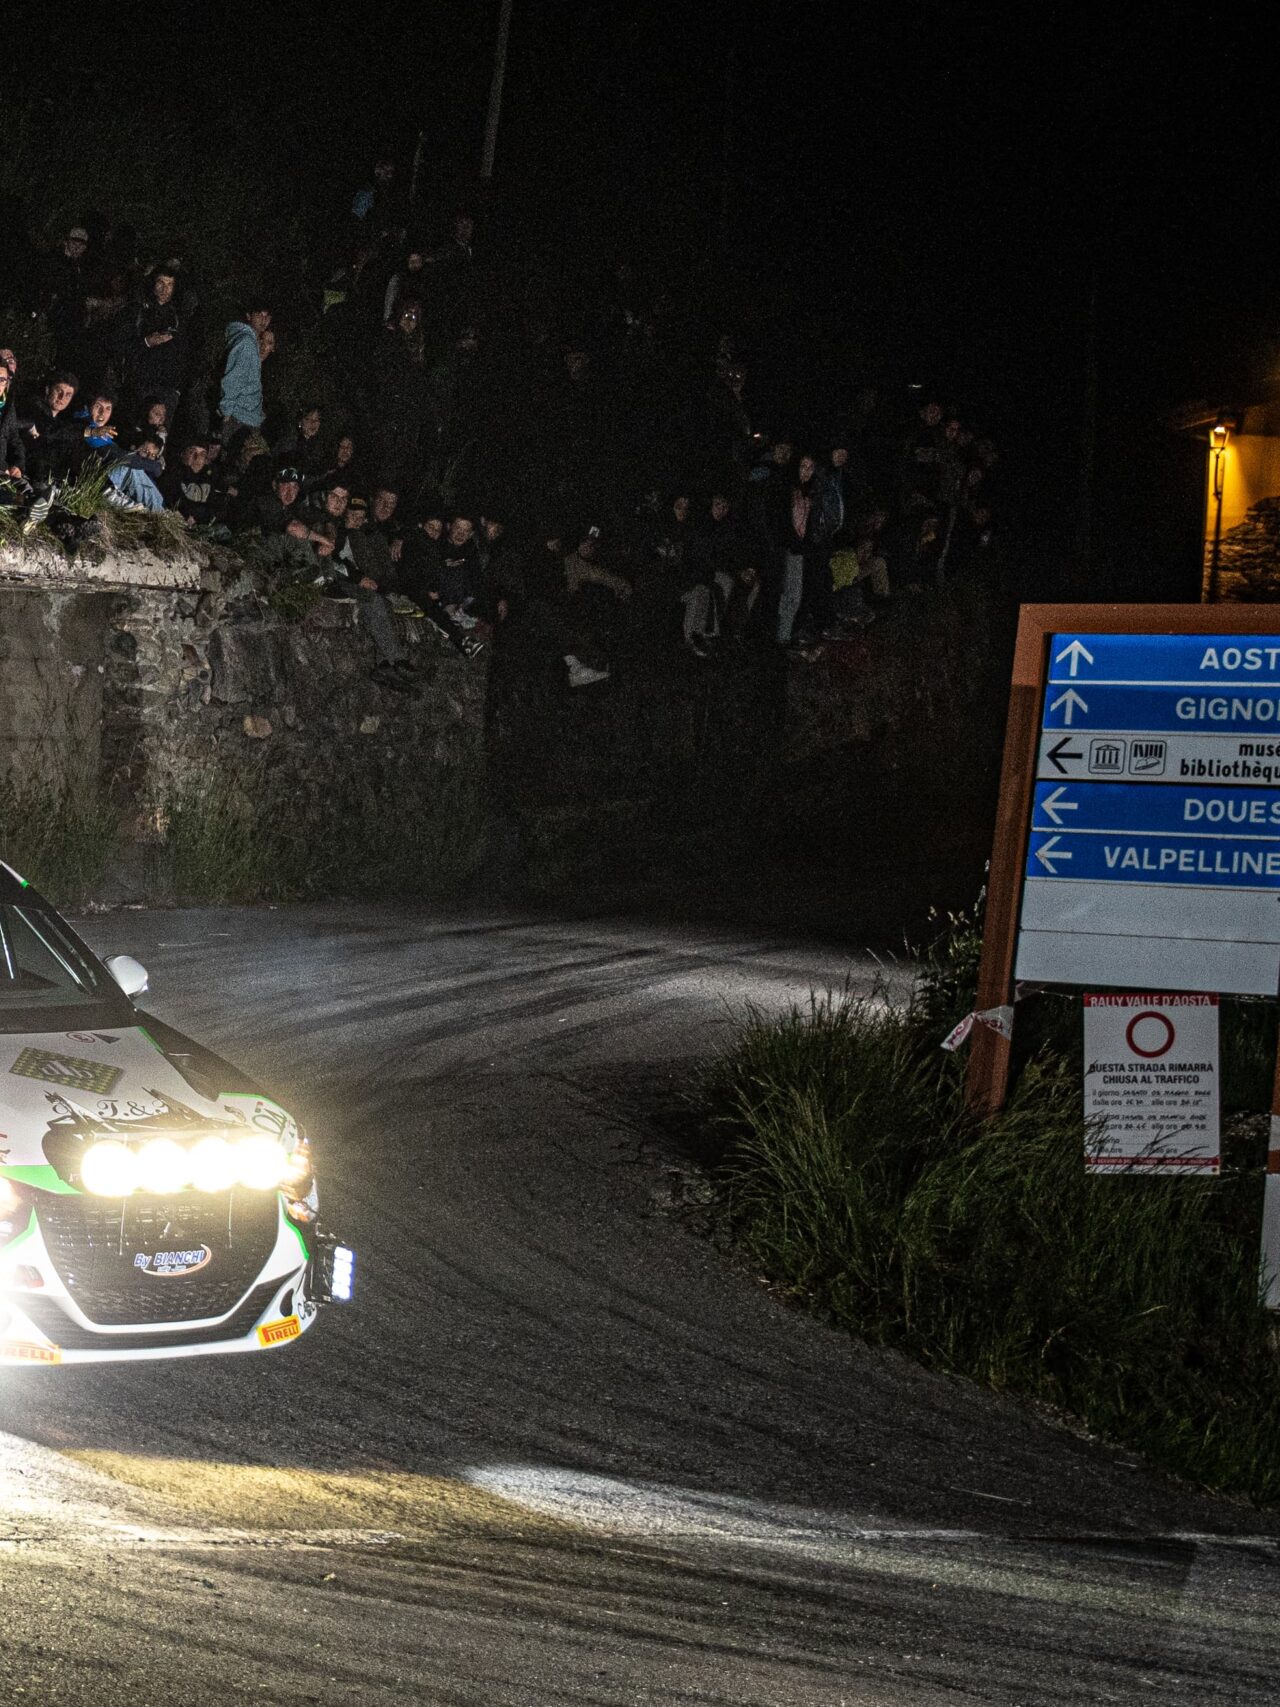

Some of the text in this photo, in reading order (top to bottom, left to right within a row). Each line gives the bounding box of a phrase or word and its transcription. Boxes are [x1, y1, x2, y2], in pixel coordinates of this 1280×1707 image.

[1176, 697, 1280, 721] GIGNO
[1104, 846, 1280, 876] VALPELLINE
[1090, 996, 1124, 1008] RALLY
[1126, 995, 1160, 1007] VALLE
[1127, 1063, 1166, 1073] STRADA
[1102, 1075, 1200, 1085] CHIUSA AL TRAFFICO
[134, 1253, 153, 1270] By
[153, 1250, 206, 1266] BIANCHI
[262, 1318, 299, 1343] PIRELLI
